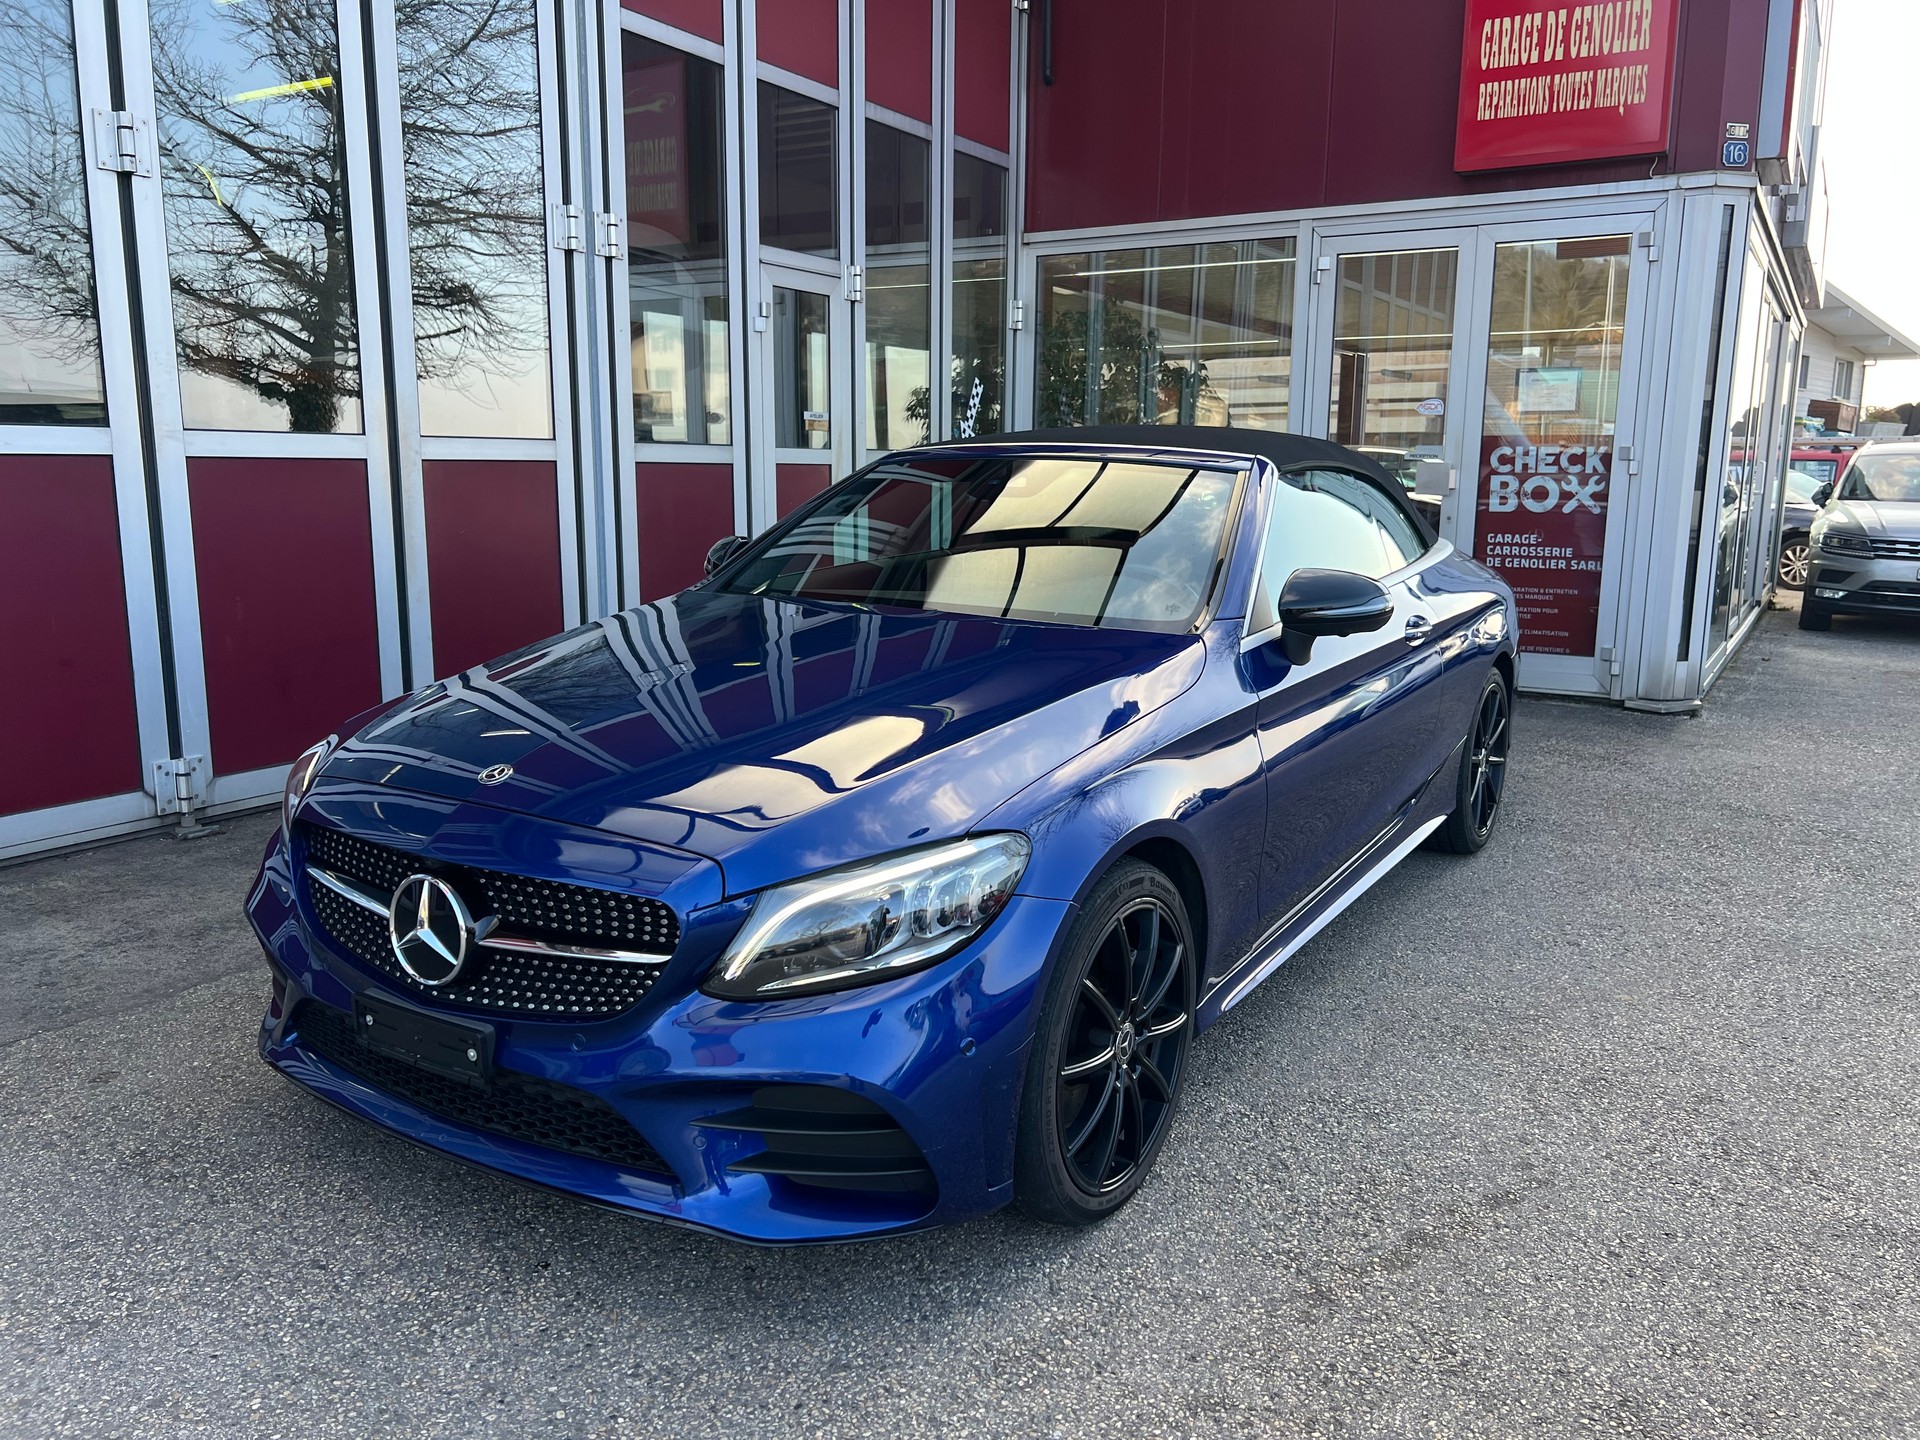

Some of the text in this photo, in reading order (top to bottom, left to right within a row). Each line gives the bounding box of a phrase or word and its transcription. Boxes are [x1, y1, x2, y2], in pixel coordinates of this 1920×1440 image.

[1480, 0, 1653, 70] GARAGE DE GENOLIER
[1477, 64, 1648, 121] REPARATIONS TOUTES MARQUES
[1728, 144, 1744, 162] 16
[1490, 446, 1608, 473] CHECK
[1489, 475, 1605, 514] BOX
[1487, 534, 1542, 544] GARAGE-
[1487, 546, 1573, 557] CARROSSERIE
[1486, 557, 1501, 567] DE
[1505, 558, 1566, 569] GENOLIER
